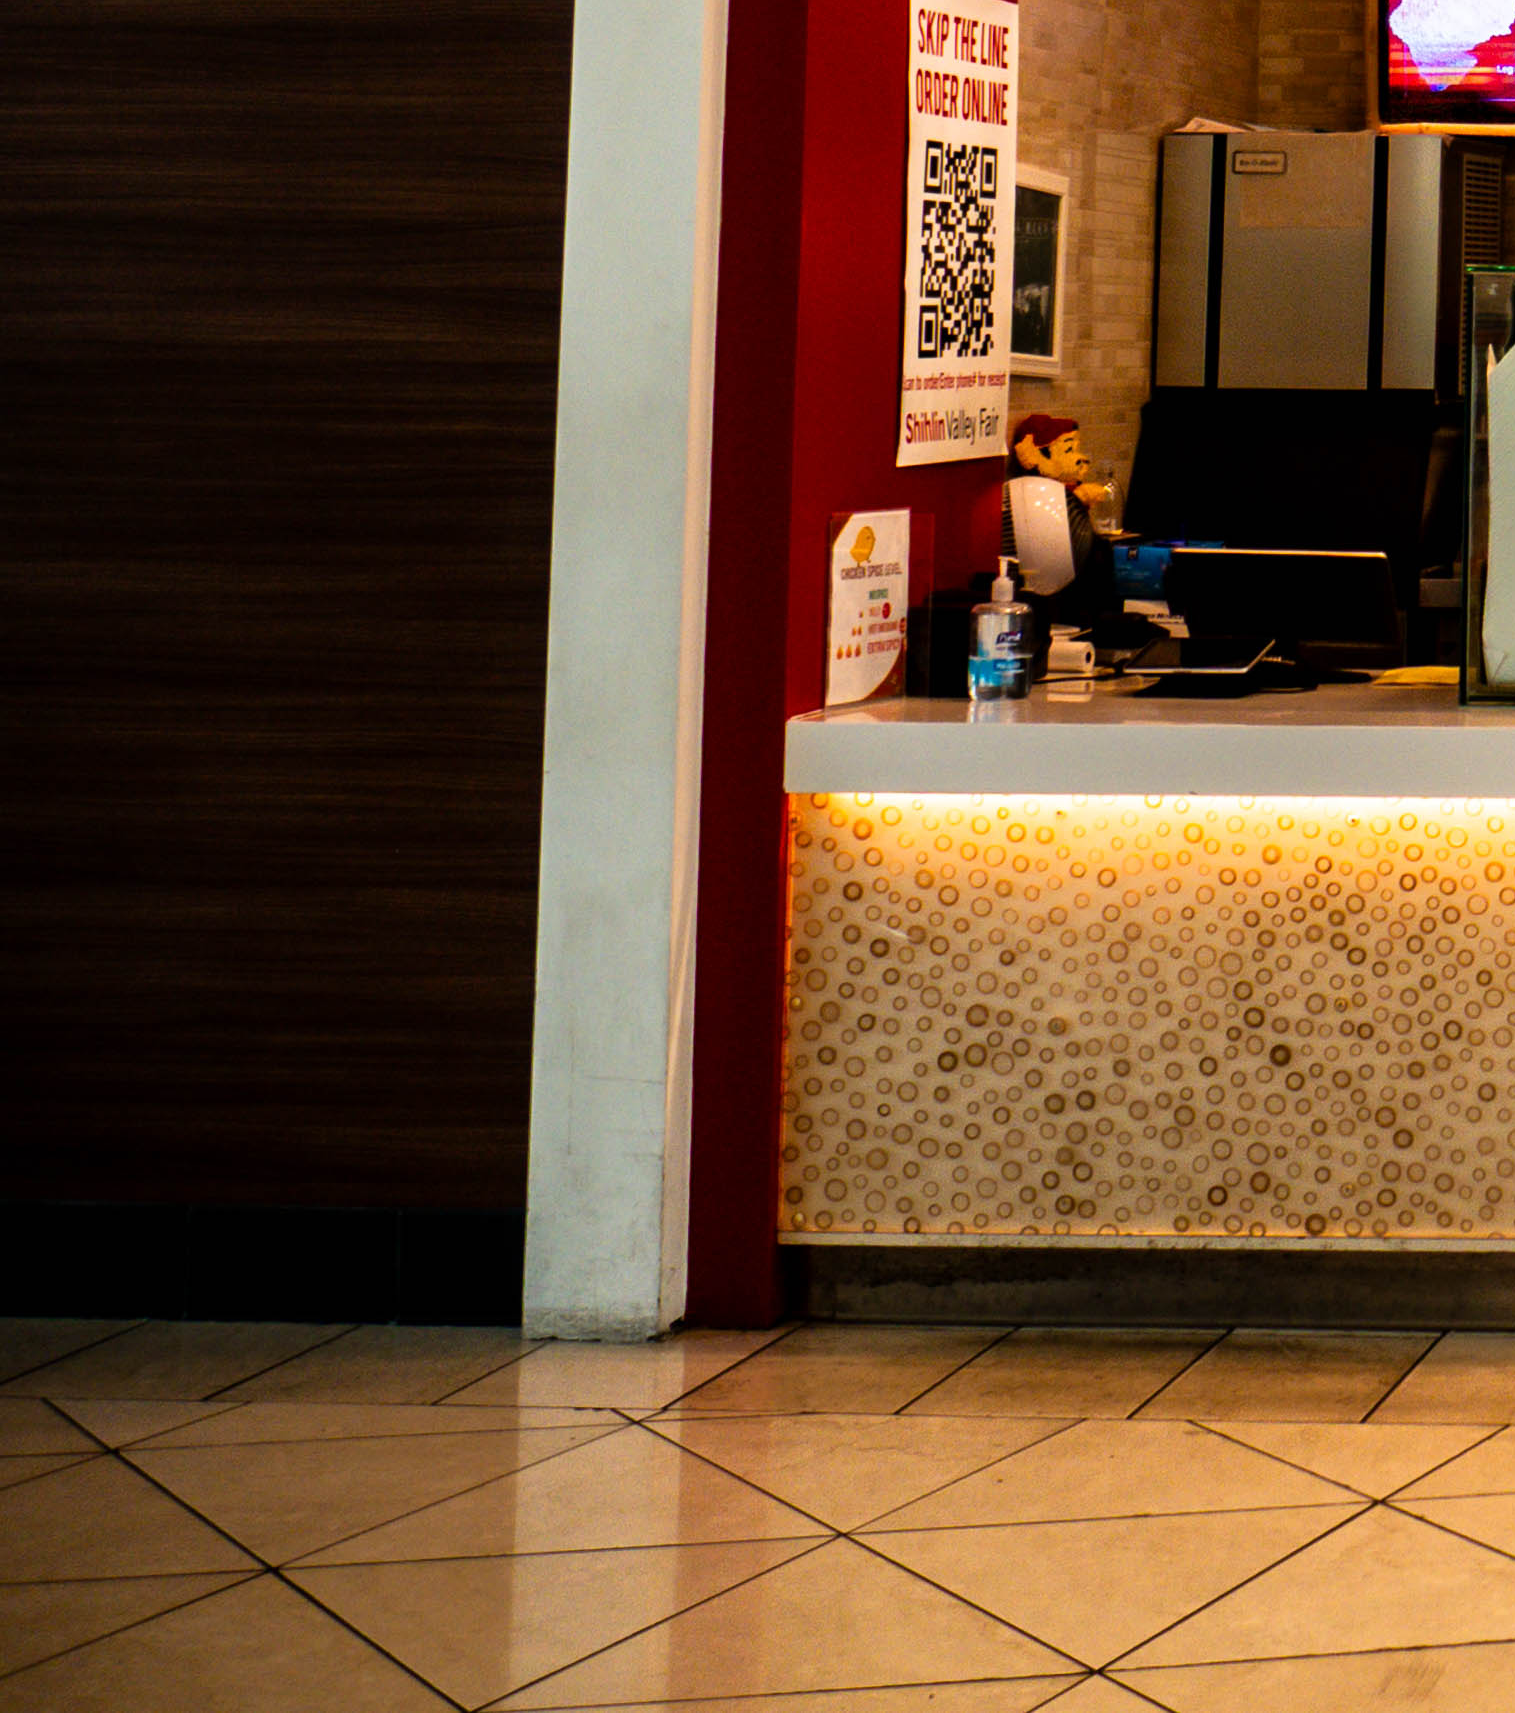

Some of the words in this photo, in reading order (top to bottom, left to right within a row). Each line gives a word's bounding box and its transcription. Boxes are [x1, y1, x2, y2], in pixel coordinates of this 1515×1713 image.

[918, 8, 949, 57] SKIP
[954, 16, 979, 63] THE
[981, 23, 1009, 69] LINE
[916, 68, 959, 119] ORDER
[962, 77, 1008, 126] ONLINE
[905, 411, 945, 444] Shihlin
[945, 409, 977, 446] Valley
[979, 407, 999, 438] Fair
